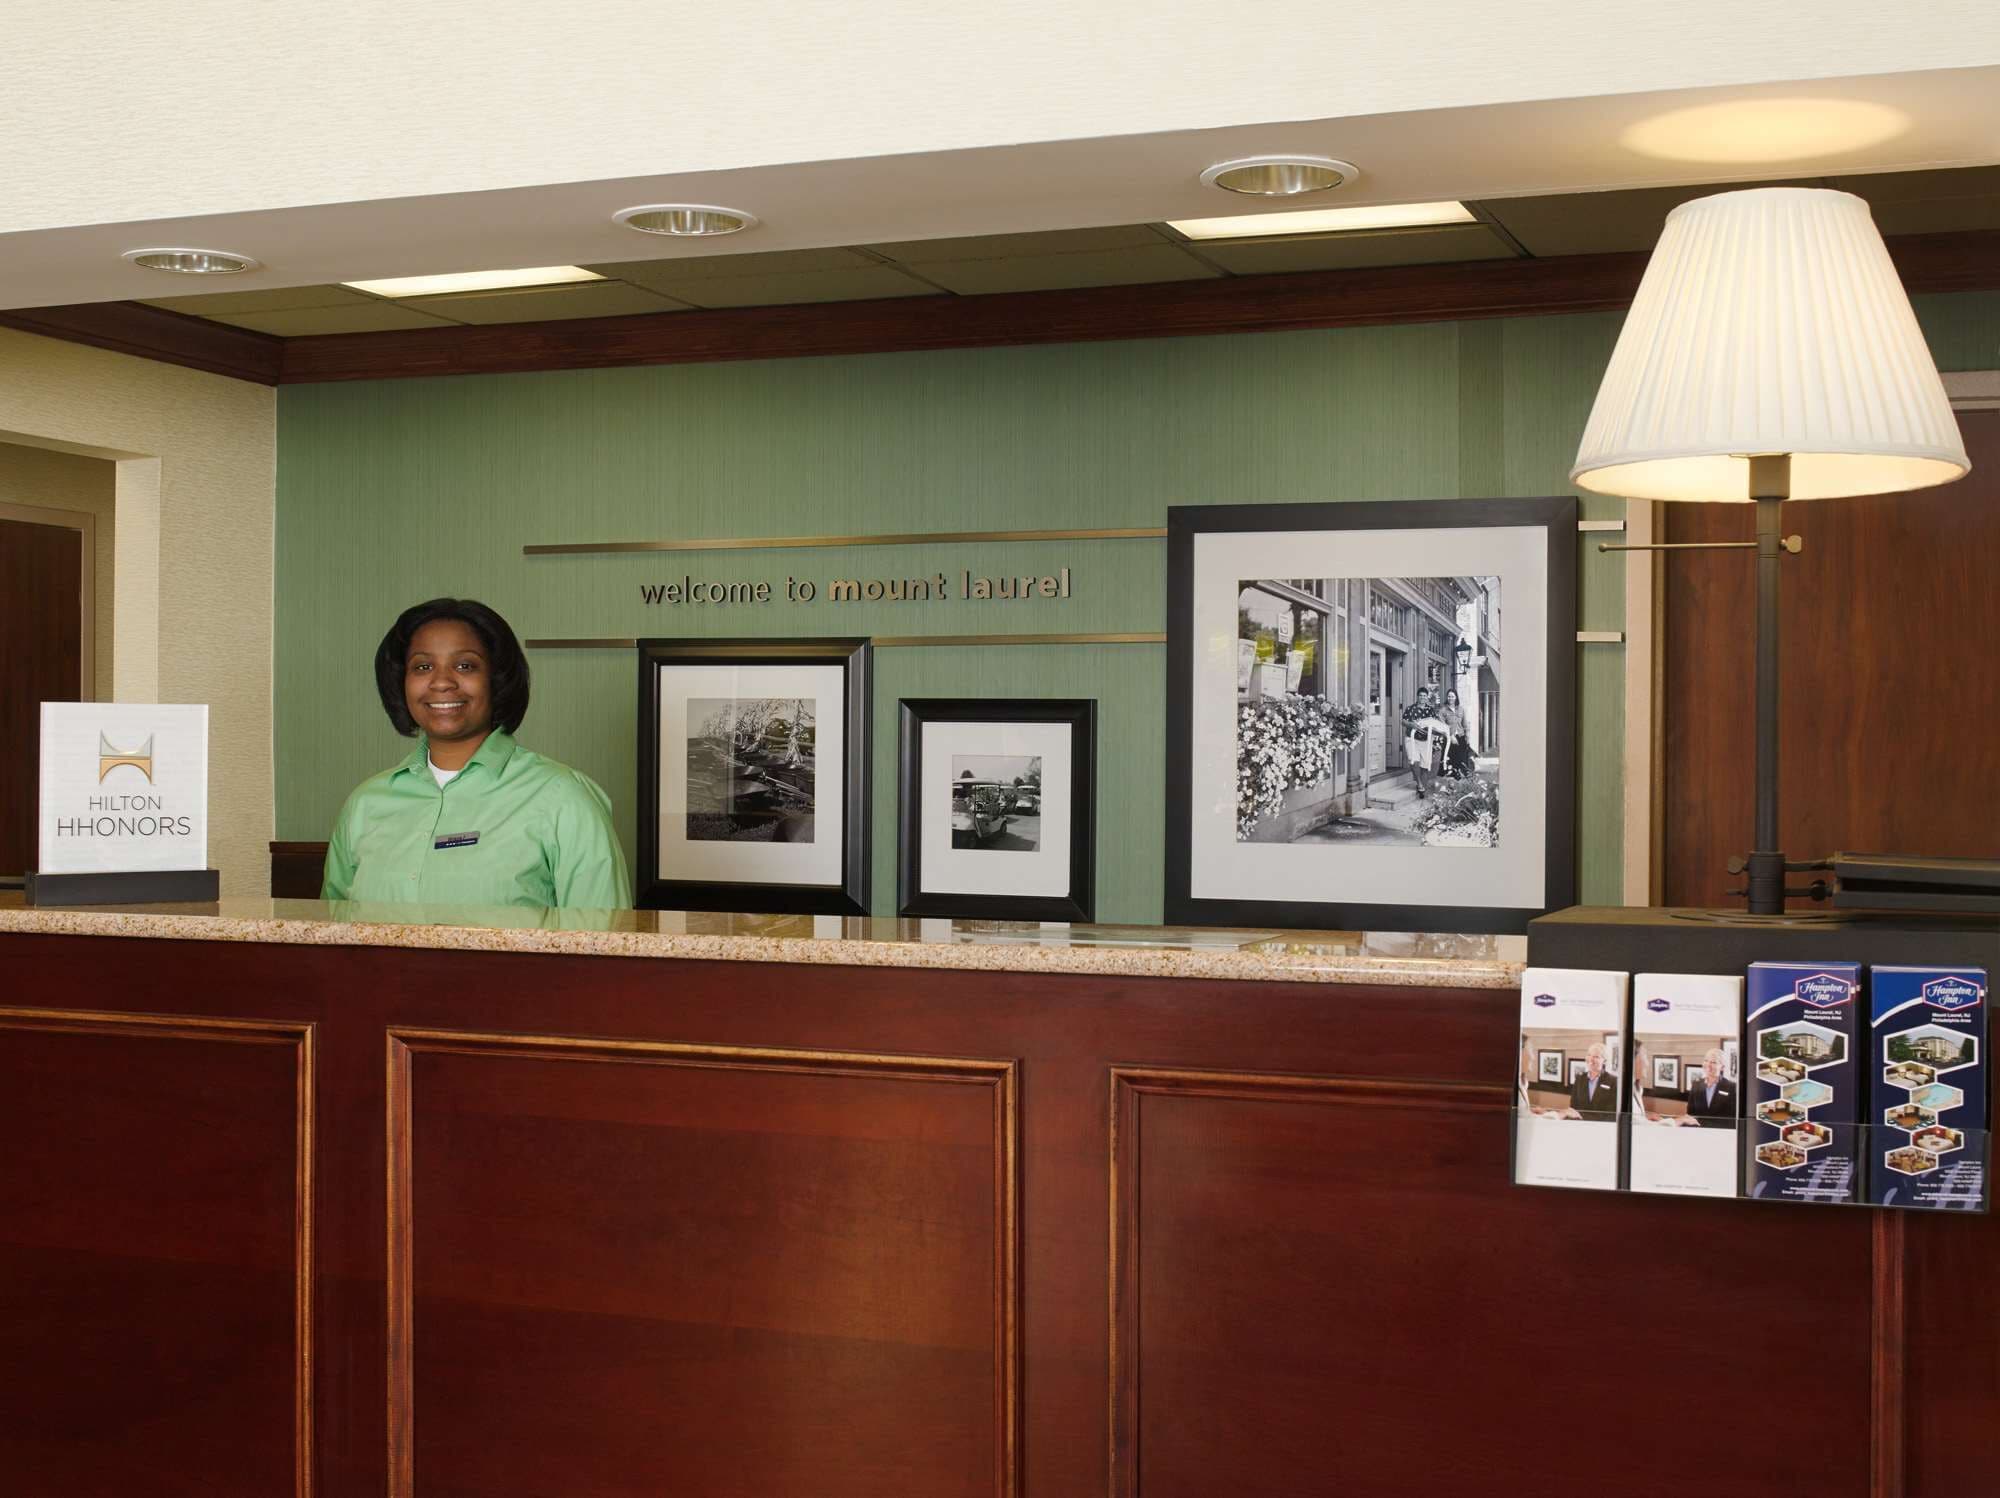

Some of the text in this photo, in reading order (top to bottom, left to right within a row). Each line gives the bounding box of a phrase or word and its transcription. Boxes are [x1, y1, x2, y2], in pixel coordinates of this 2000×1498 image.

[640, 568, 1070, 604] welcome to mount laurel
[89, 795, 161, 811] HILTON
[57, 816, 191, 837] HHONORS
[1800, 982, 1847, 994] Hampton
[1927, 985, 1976, 997] Hampton
[1810, 992, 1834, 1002] Inn
[1938, 995, 1963, 1005] Inn
